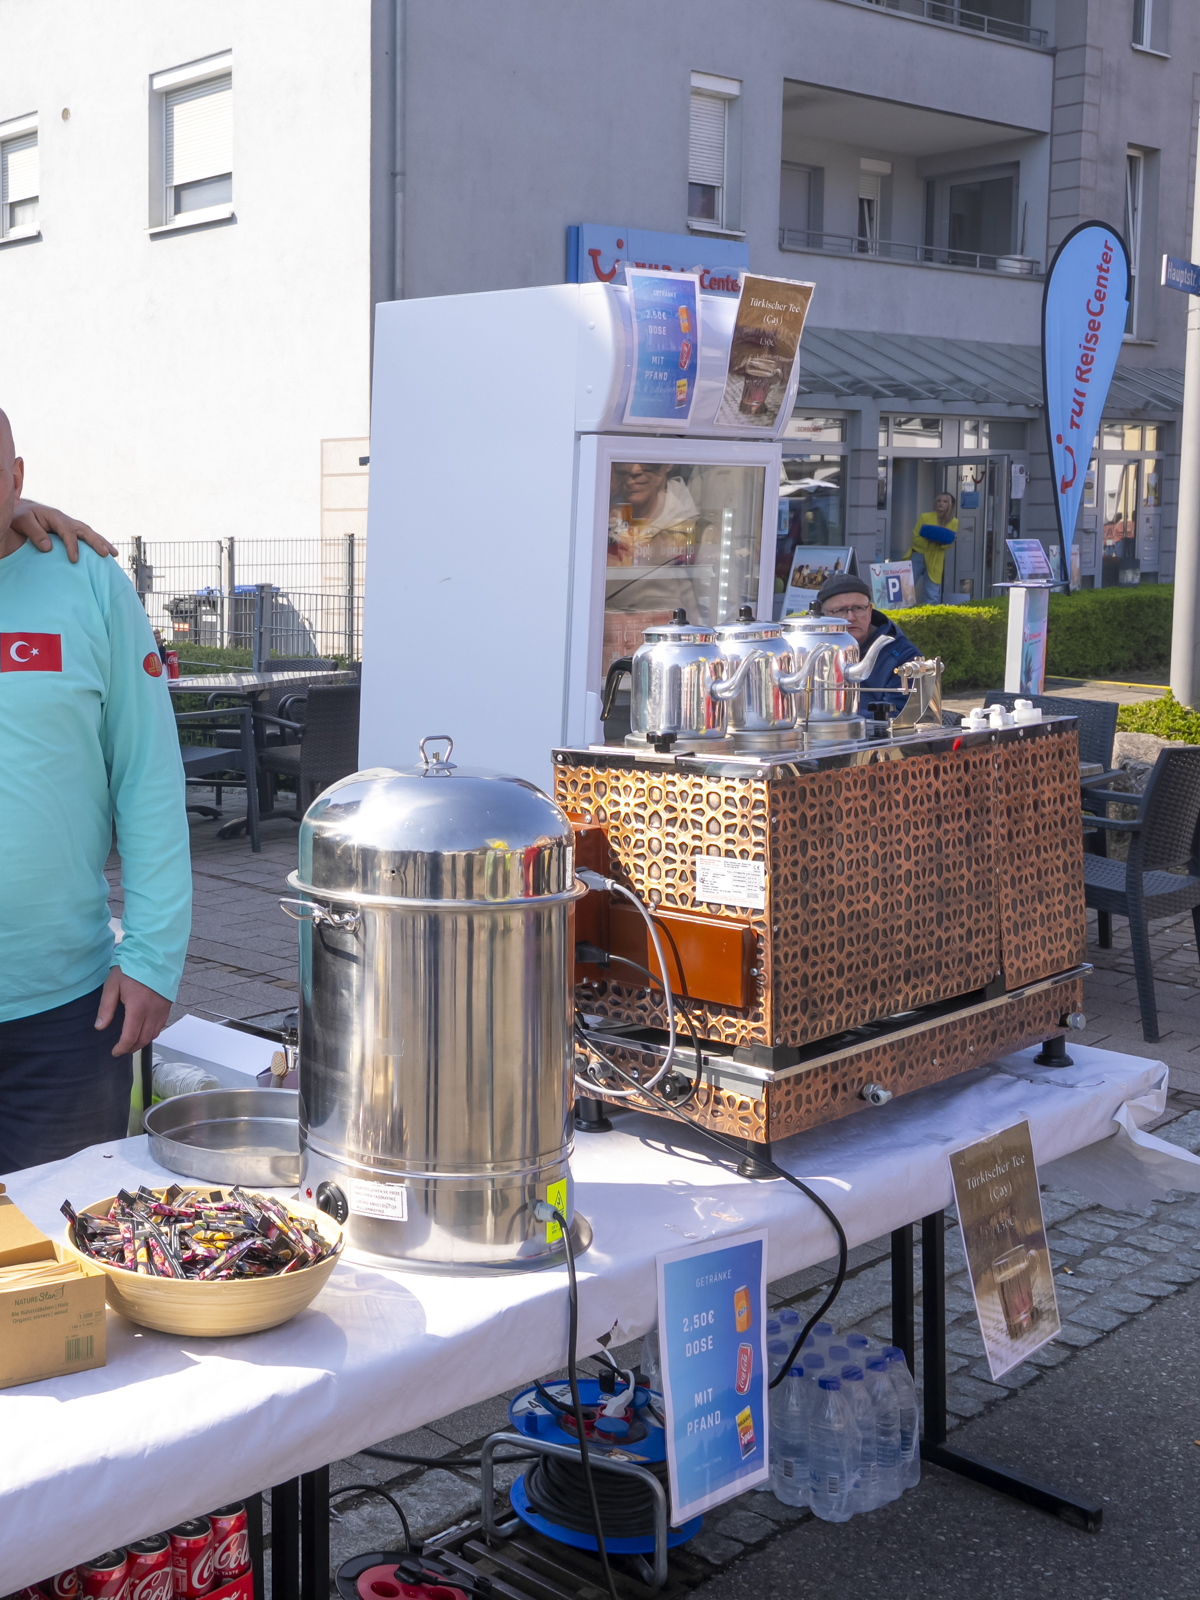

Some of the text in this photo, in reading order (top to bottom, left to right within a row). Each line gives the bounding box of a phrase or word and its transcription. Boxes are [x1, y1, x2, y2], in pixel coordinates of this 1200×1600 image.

[700, 269, 741, 292] Cente
[1167, 261, 1197, 288] Hauptstr.
[750, 297, 801, 313] Türkischer Tee
[648, 325, 667, 335] DOSE
[1070, 239, 1114, 430] TUI ReiseCenter
[651, 356, 665, 365] MIT
[644, 371, 668, 380] PFAND
[966, 1154, 1026, 1190] Türkischer Tee
[989, 1180, 1012, 1203] (Çay)
[695, 1269, 732, 1288] GETRÄNKE
[14, 1296, 38, 1306] NATURE
[20, 1304, 54, 1315] Rührstäbchen
[12, 1316, 32, 1324] Organic
[682, 1309, 715, 1333] 2,50€
[685, 1335, 714, 1358] DOSE
[694, 1388, 713, 1408] MIT
[687, 1410, 721, 1437] PFAND
